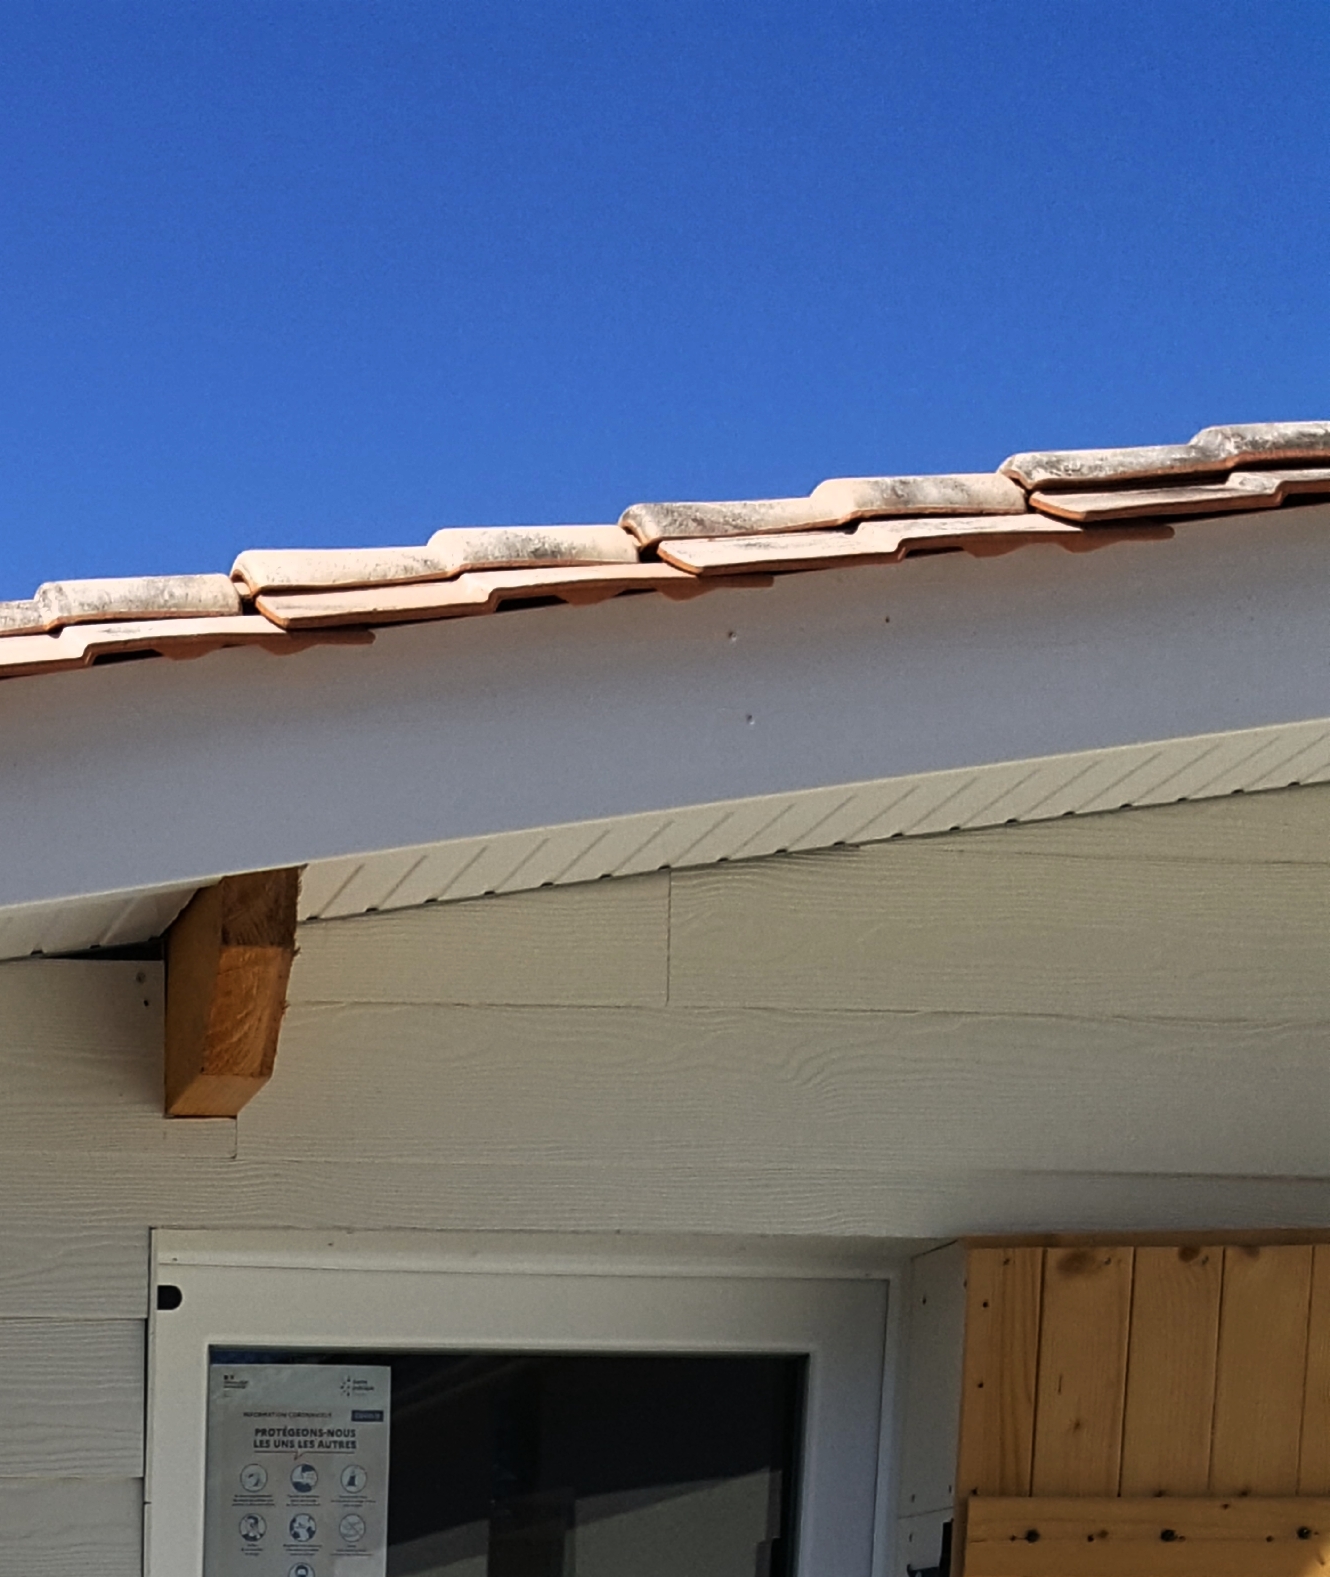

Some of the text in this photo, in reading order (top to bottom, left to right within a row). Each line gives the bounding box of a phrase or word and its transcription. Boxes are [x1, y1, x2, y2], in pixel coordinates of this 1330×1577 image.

[254, 1426, 356, 1438] PROTÉGEONS-NOUS
[253, 1439, 357, 1449] LES UNS LES AUTRES
